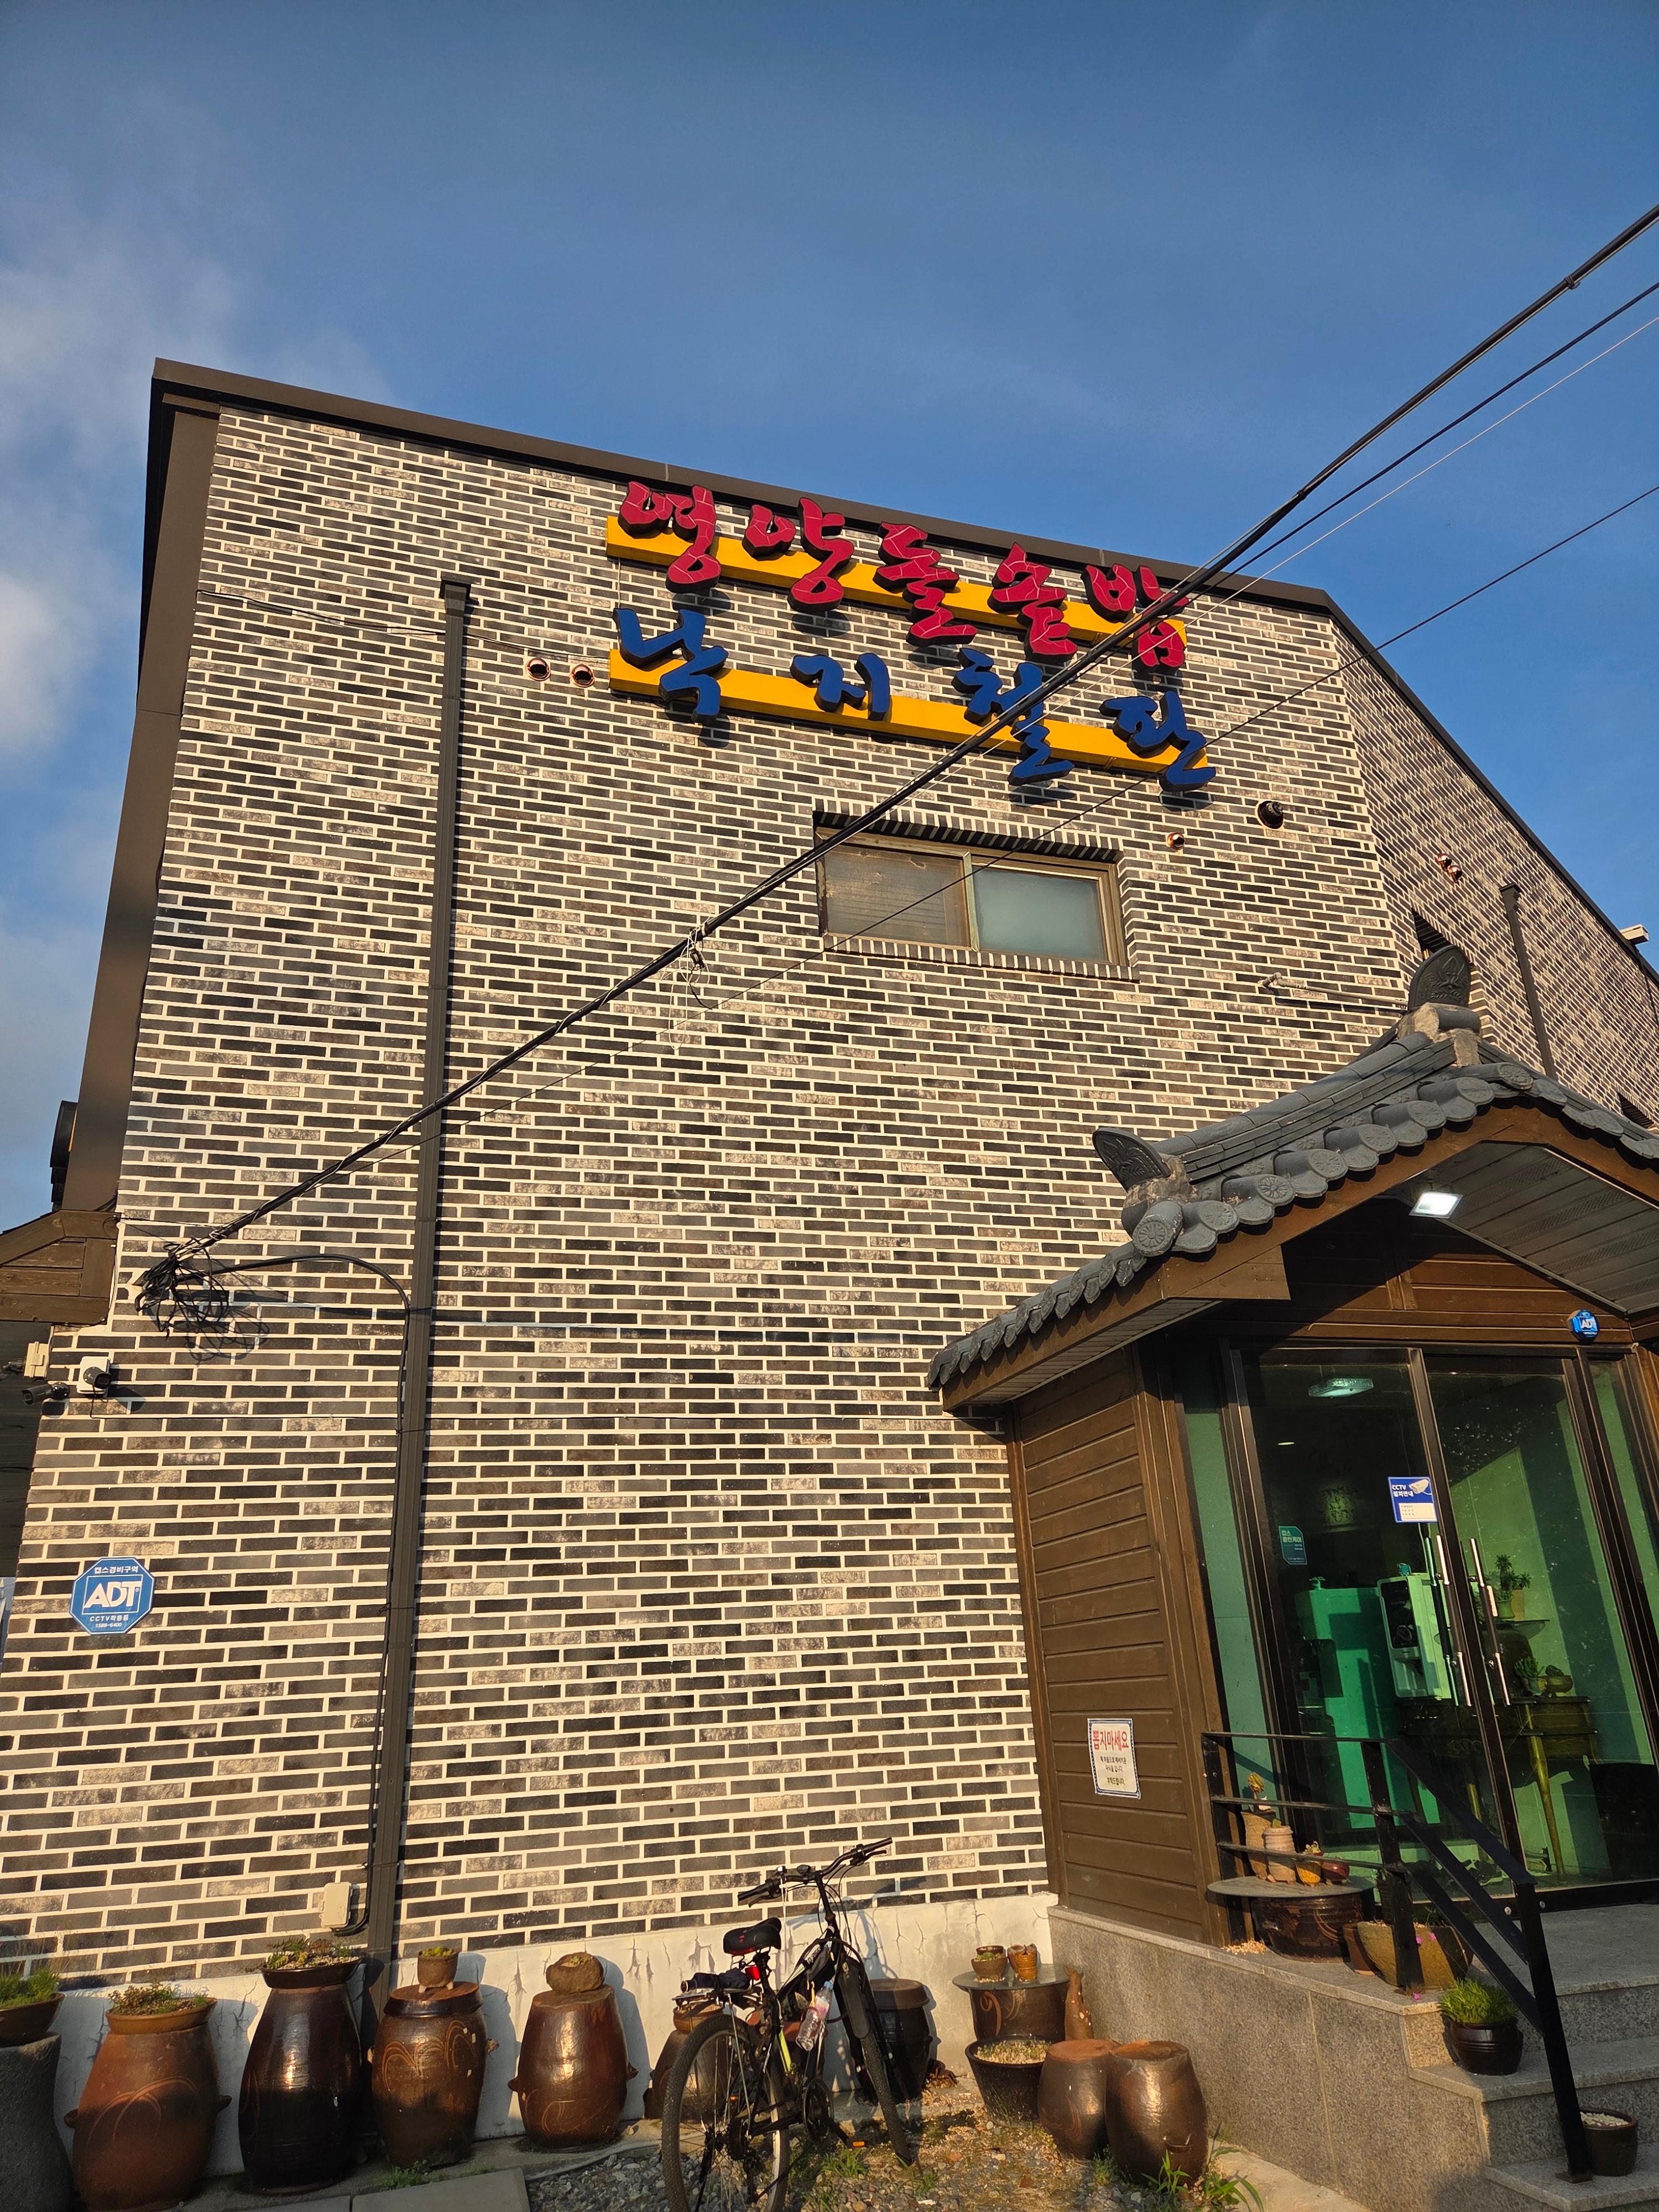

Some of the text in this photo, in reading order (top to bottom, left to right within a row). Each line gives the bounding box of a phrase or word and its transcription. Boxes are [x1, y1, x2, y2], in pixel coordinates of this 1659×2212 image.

[618, 481, 1191, 670] 영양돌솥밥
[613, 608, 1216, 792] 낙지철판
[95, 1566, 138, 1574] 캡스경비구역
[84, 1580, 142, 1609] ADT
[1093, 1730, 1129, 1751] 뽑지마세요
